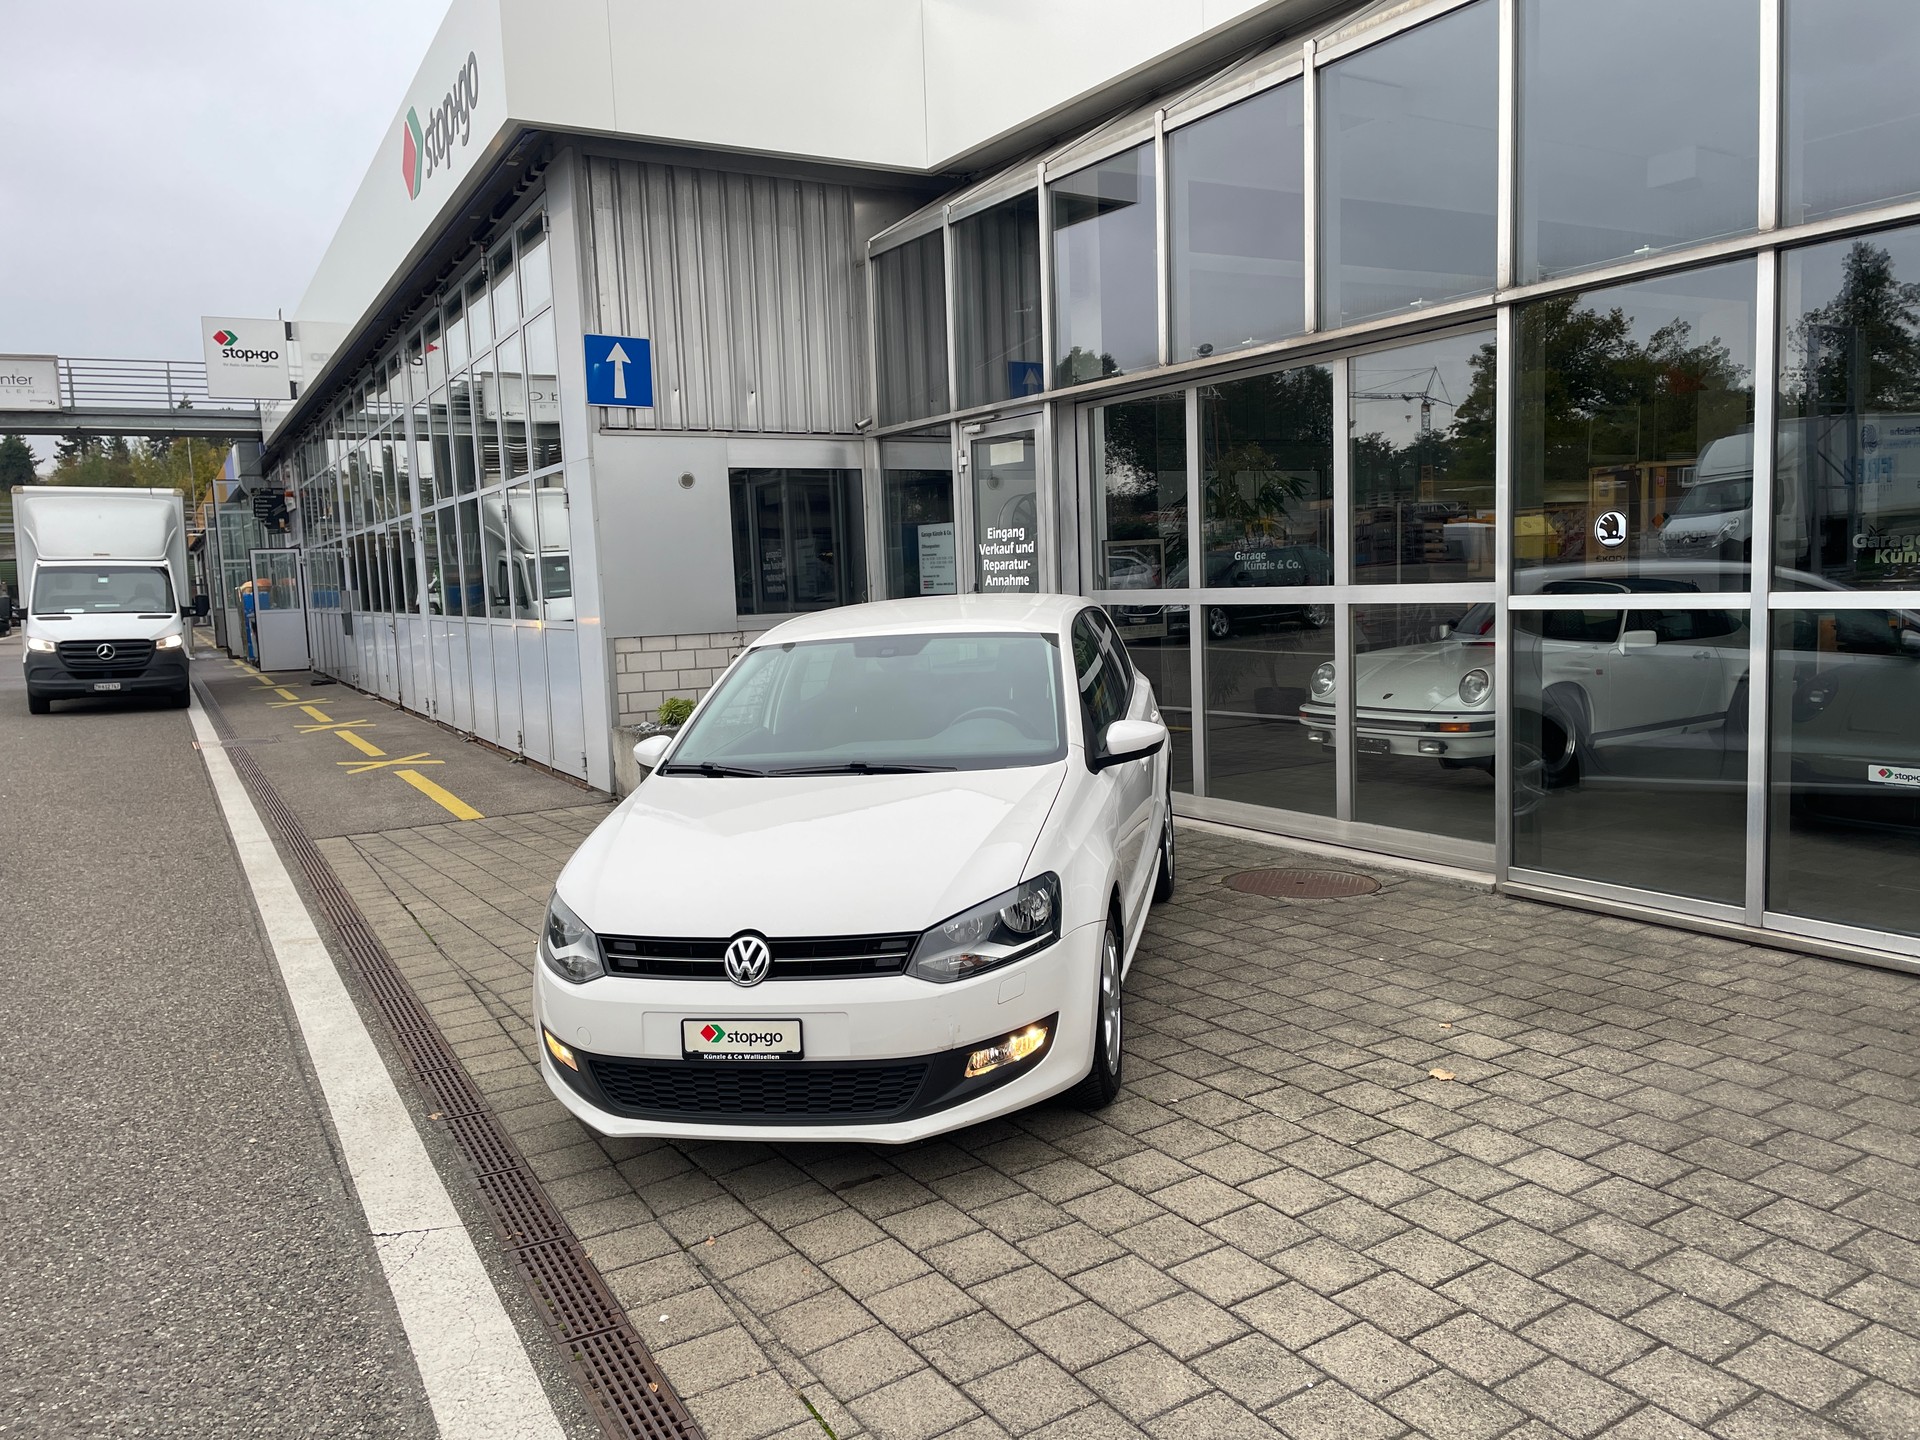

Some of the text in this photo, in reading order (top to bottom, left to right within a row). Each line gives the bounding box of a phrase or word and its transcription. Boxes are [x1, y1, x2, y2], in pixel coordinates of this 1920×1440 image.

[425, 51, 479, 179] stop+go
[222, 347, 279, 363] stop+go
[987, 527, 1025, 541] Eingang
[979, 541, 1034, 555] Verkauf und
[1234, 551, 1267, 563] Garage
[983, 559, 1031, 574] Reparatur-
[1244, 560, 1302, 571] Künzle & Co.
[985, 574, 1030, 587] Annahme
[727, 1031, 783, 1047] stop+go
